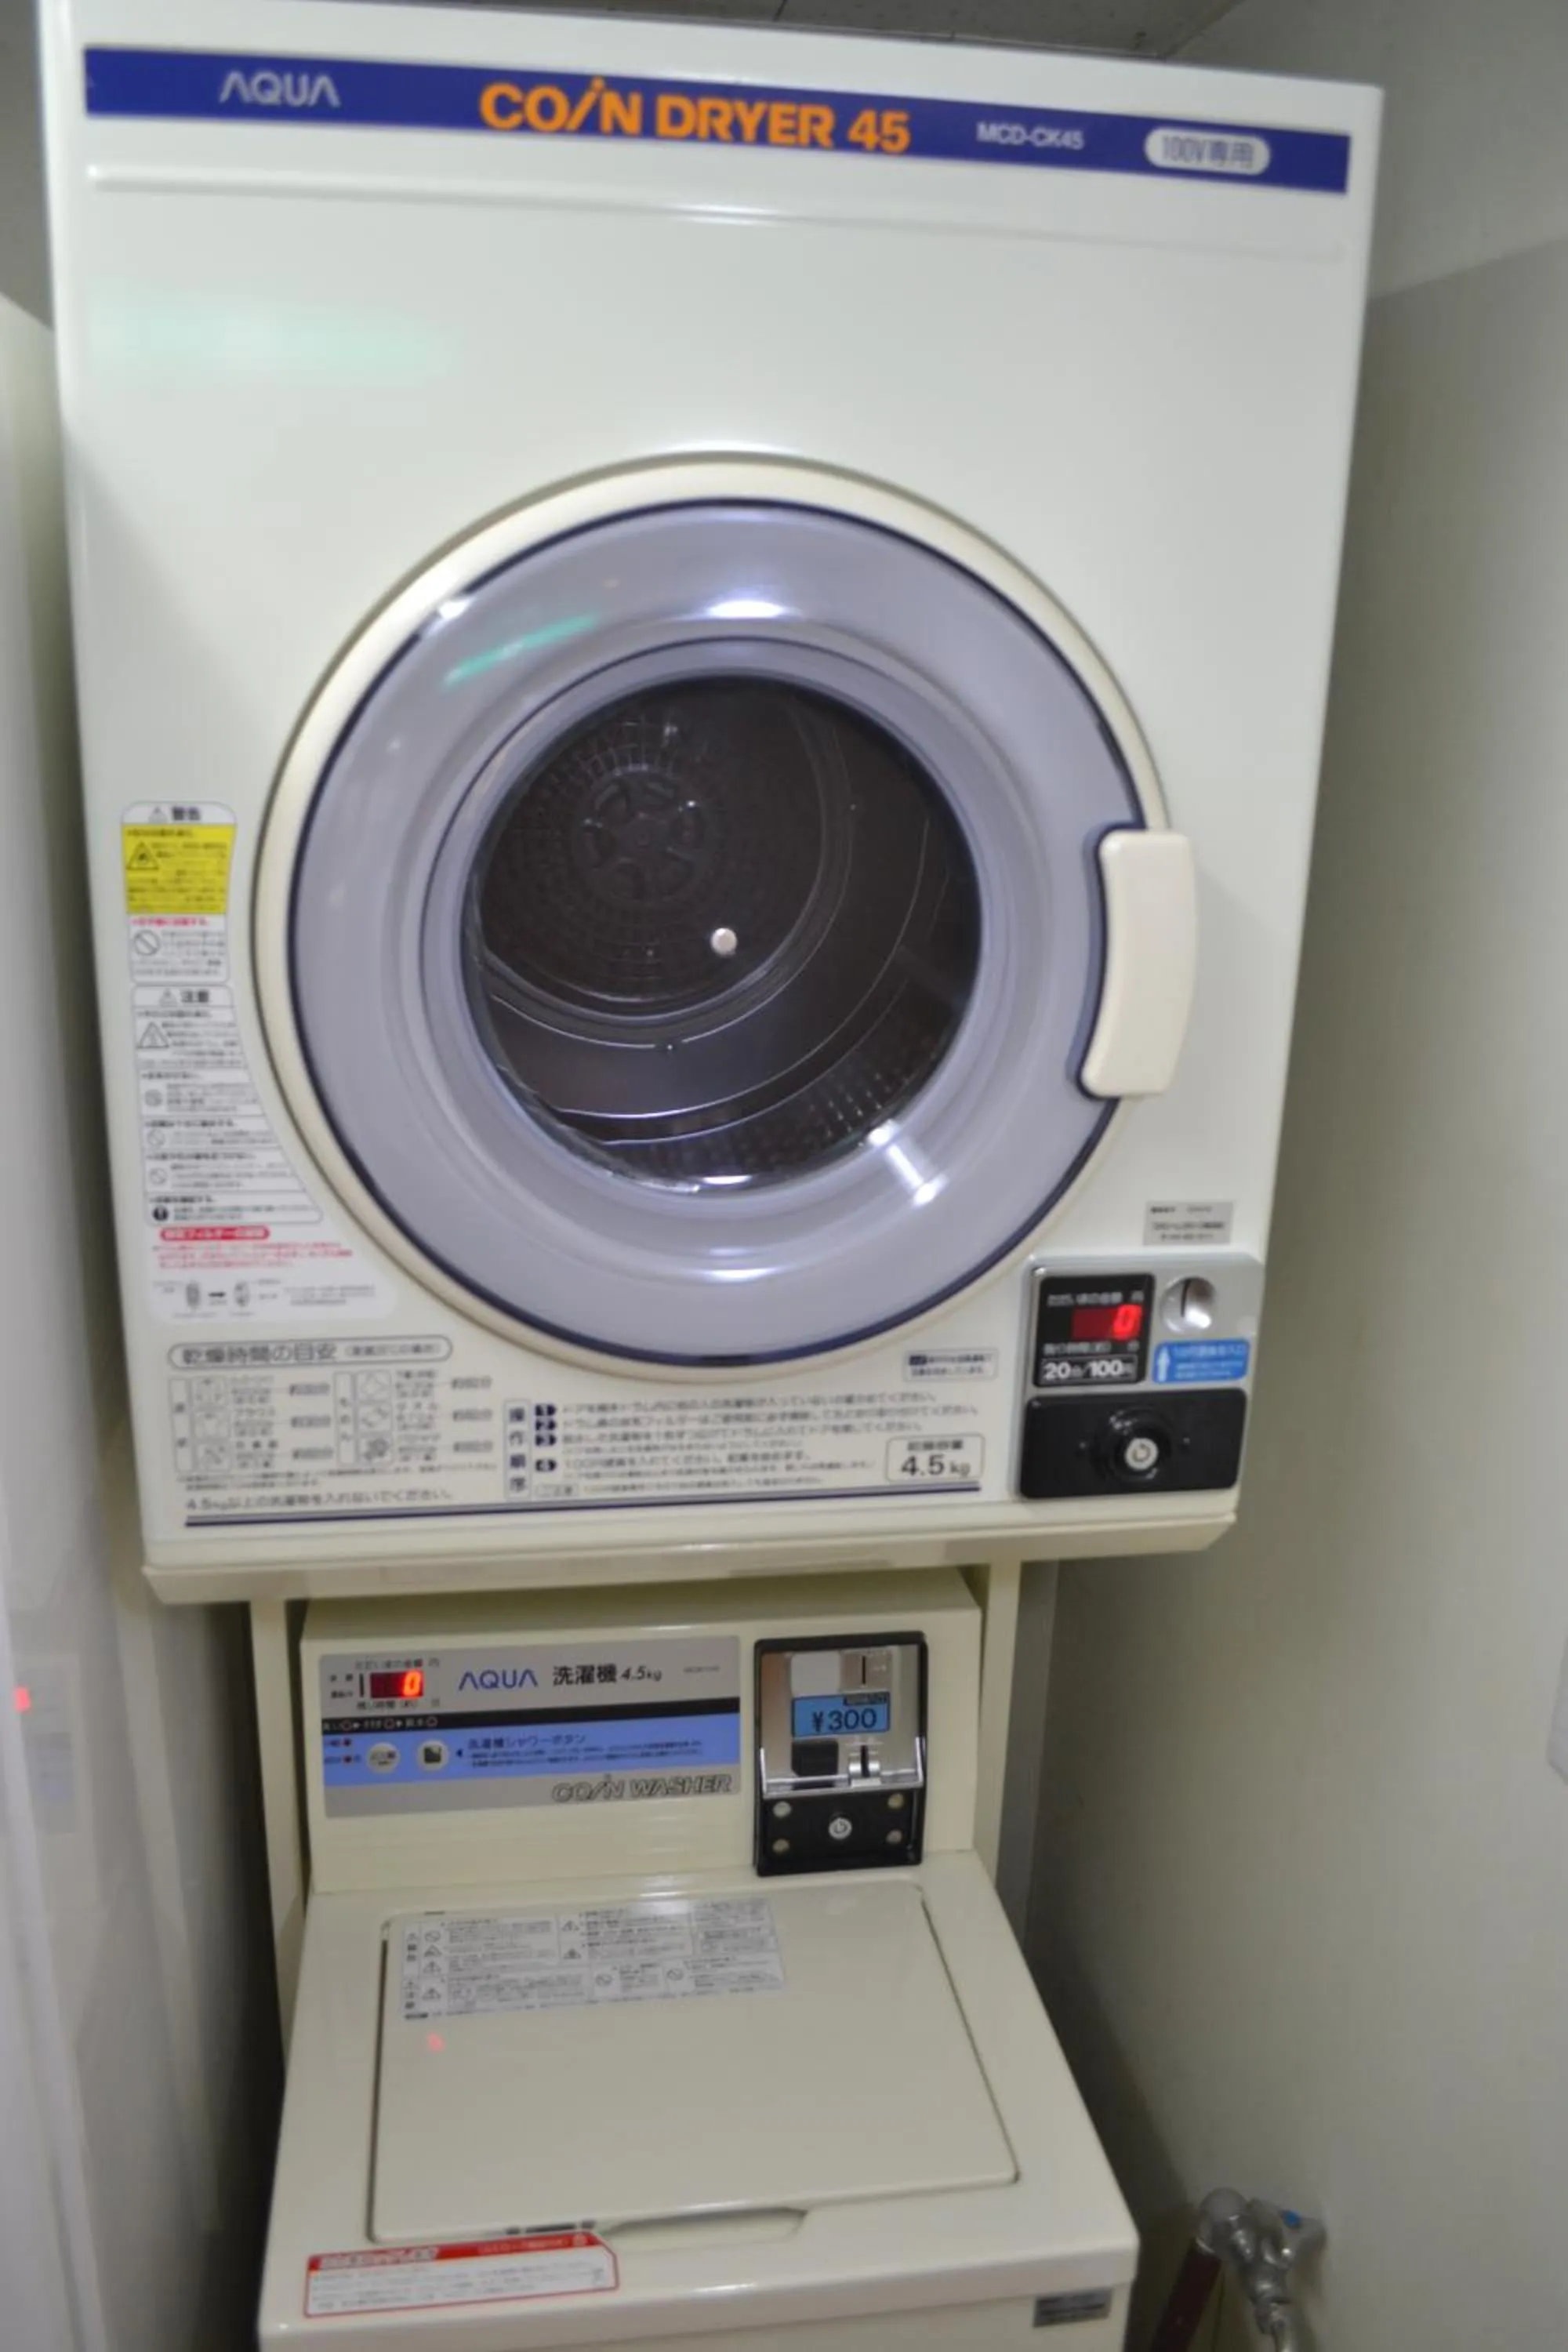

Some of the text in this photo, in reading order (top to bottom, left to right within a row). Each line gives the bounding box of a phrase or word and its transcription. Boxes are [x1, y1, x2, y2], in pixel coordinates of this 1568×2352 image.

[220, 71, 340, 108] AQUA
[479, 76, 911, 153] COIN DRYER 45
[976, 122, 1085, 151] MCD-CK45
[1113, 1304, 1142, 1340] 0
[403, 1670, 422, 1697] 0
[459, 1668, 539, 1691] AQUA
[554, 1664, 617, 1686] 洗濯機
[812, 1708, 877, 1733] ¥300
[630, 1774, 731, 1799] WASHER
